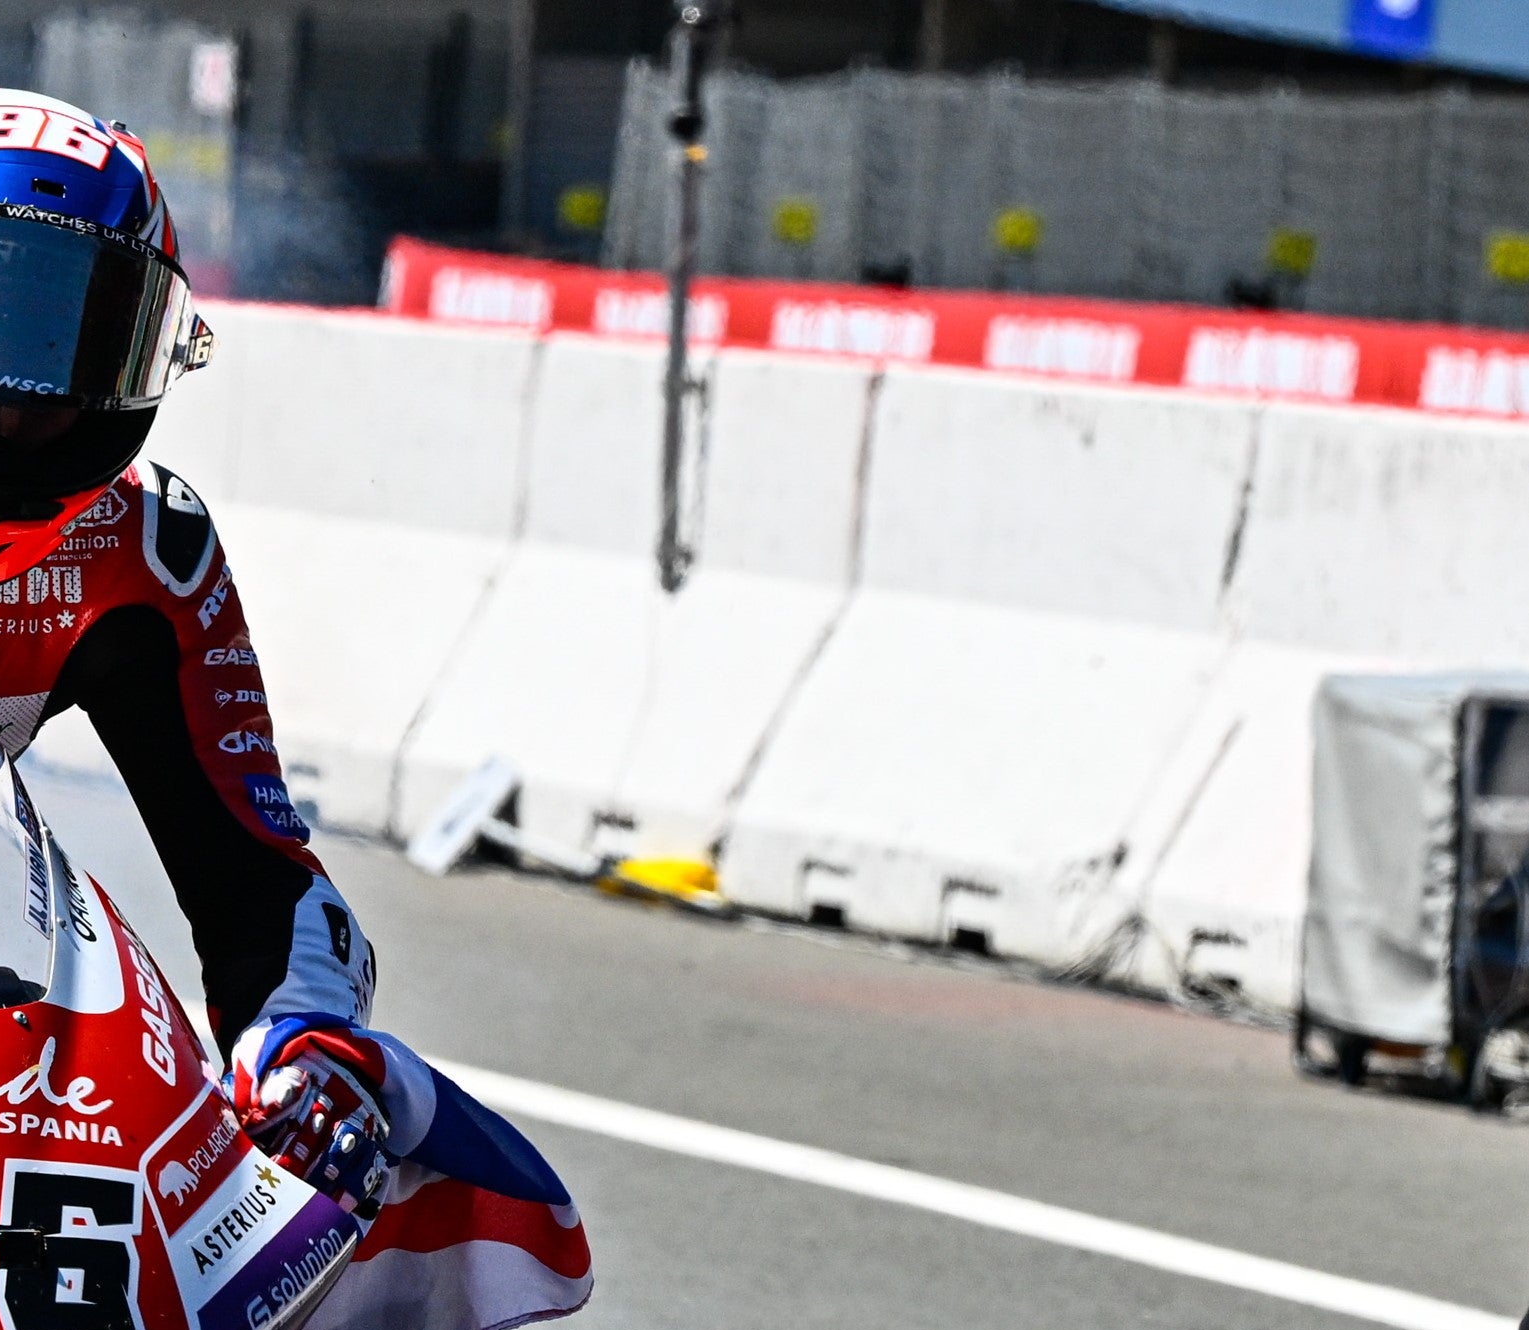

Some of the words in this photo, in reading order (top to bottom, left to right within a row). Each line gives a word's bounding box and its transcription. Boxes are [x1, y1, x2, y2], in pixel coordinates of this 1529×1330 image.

[6, 206, 98, 234] WATCHES
[103, 228, 127, 246] UK
[131, 239, 157, 260] LTD
[191, 1183, 277, 1276] ASTERIUS
[271, 1226, 346, 1307] solunion
